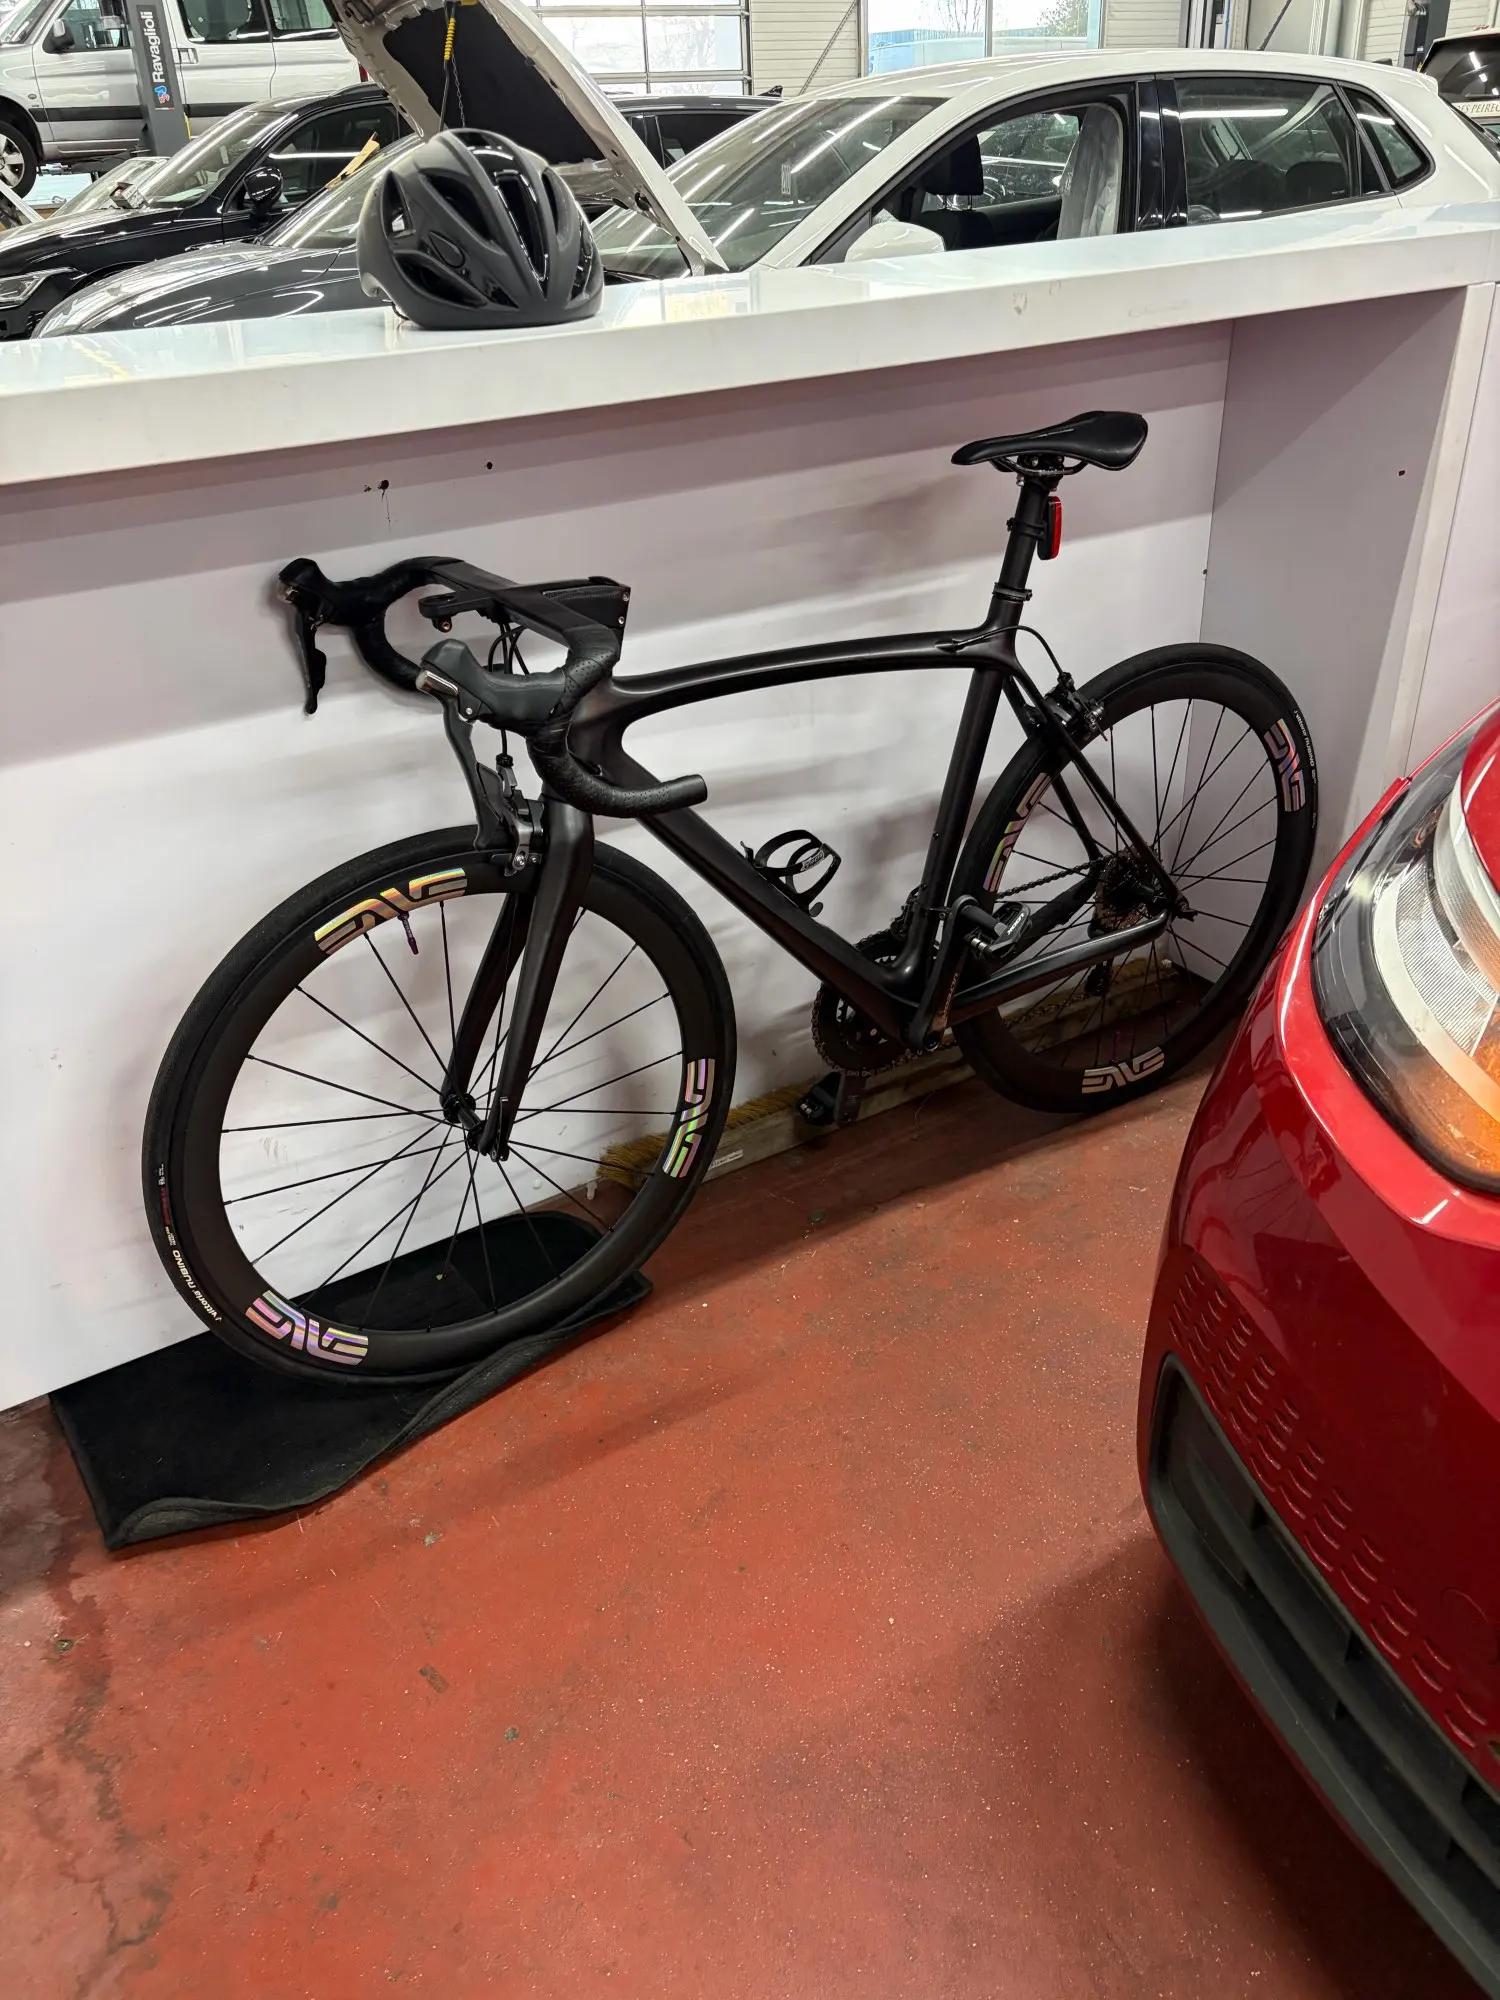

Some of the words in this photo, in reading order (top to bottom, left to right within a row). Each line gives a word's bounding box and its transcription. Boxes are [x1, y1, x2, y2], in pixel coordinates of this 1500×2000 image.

[140, 11, 166, 83] Ravaglioli
[1304, 736, 1315, 767] RUBINO
[1006, 912, 1025, 935] LOOK
[171, 1249, 197, 1289] RUBINO
[193, 1290, 221, 1321] vittoria
